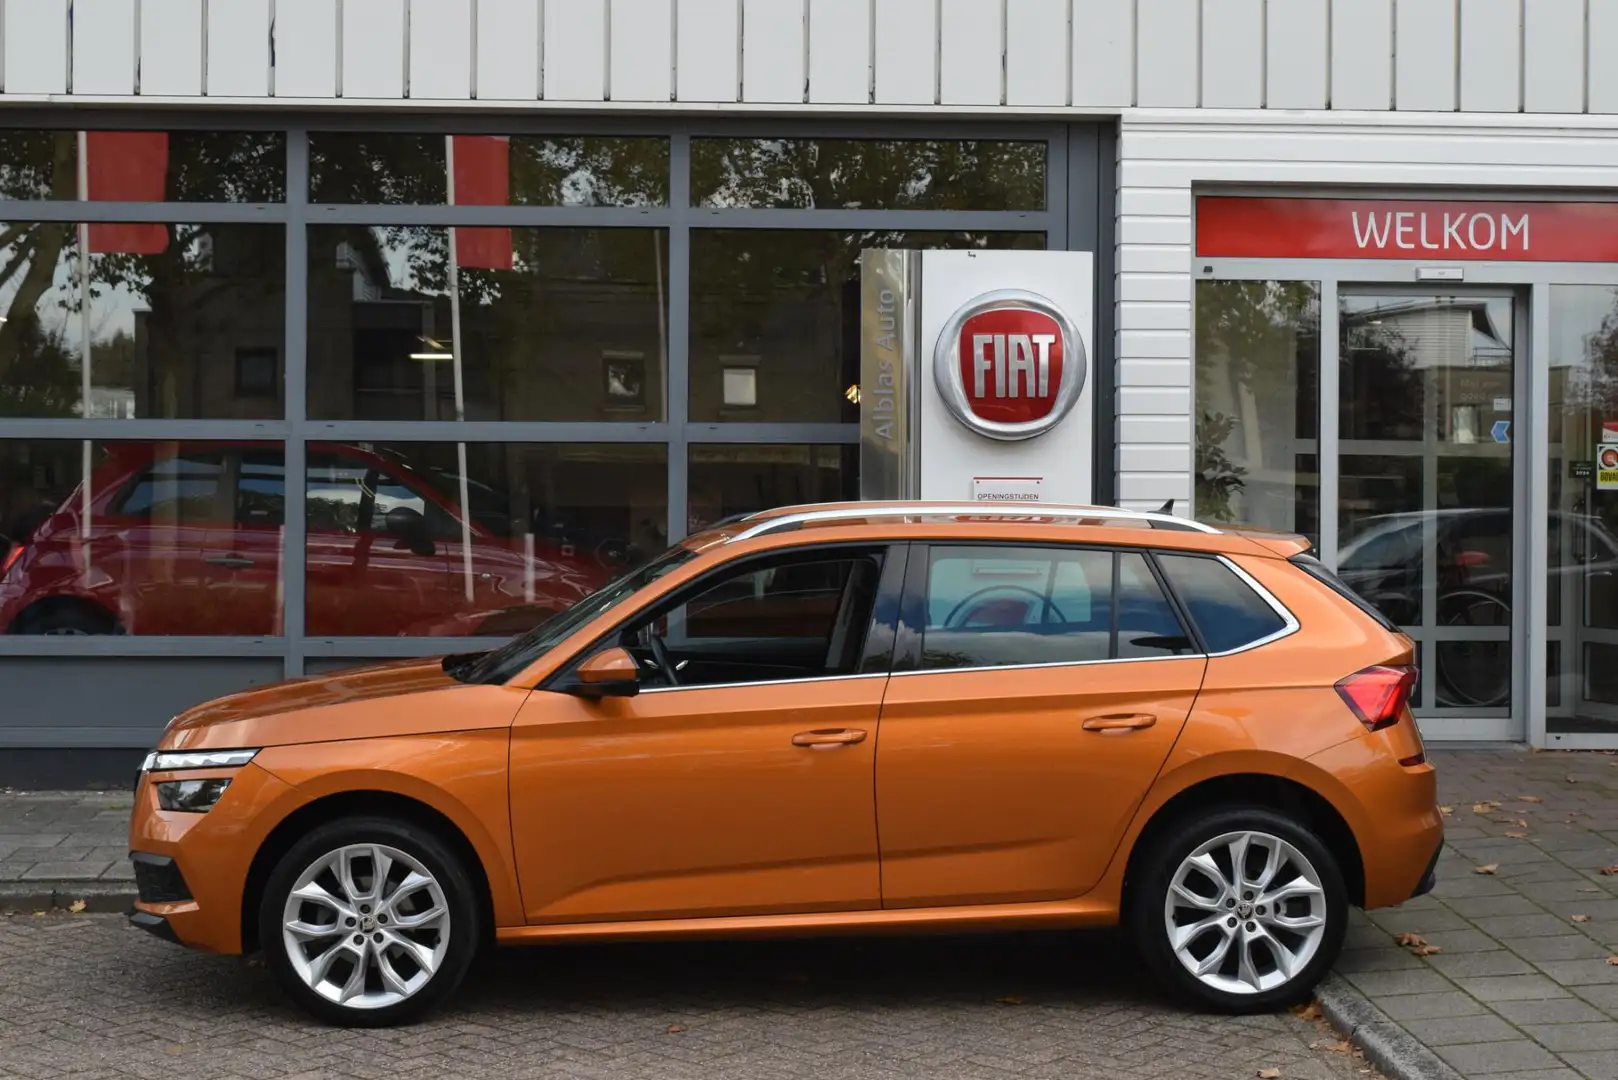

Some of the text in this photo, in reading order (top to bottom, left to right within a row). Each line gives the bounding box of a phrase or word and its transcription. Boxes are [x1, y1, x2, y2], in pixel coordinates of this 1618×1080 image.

[1351, 211, 1529, 250] WELKOM
[873, 289, 895, 440] Alblas Auto
[973, 334, 1056, 398] FIAT
